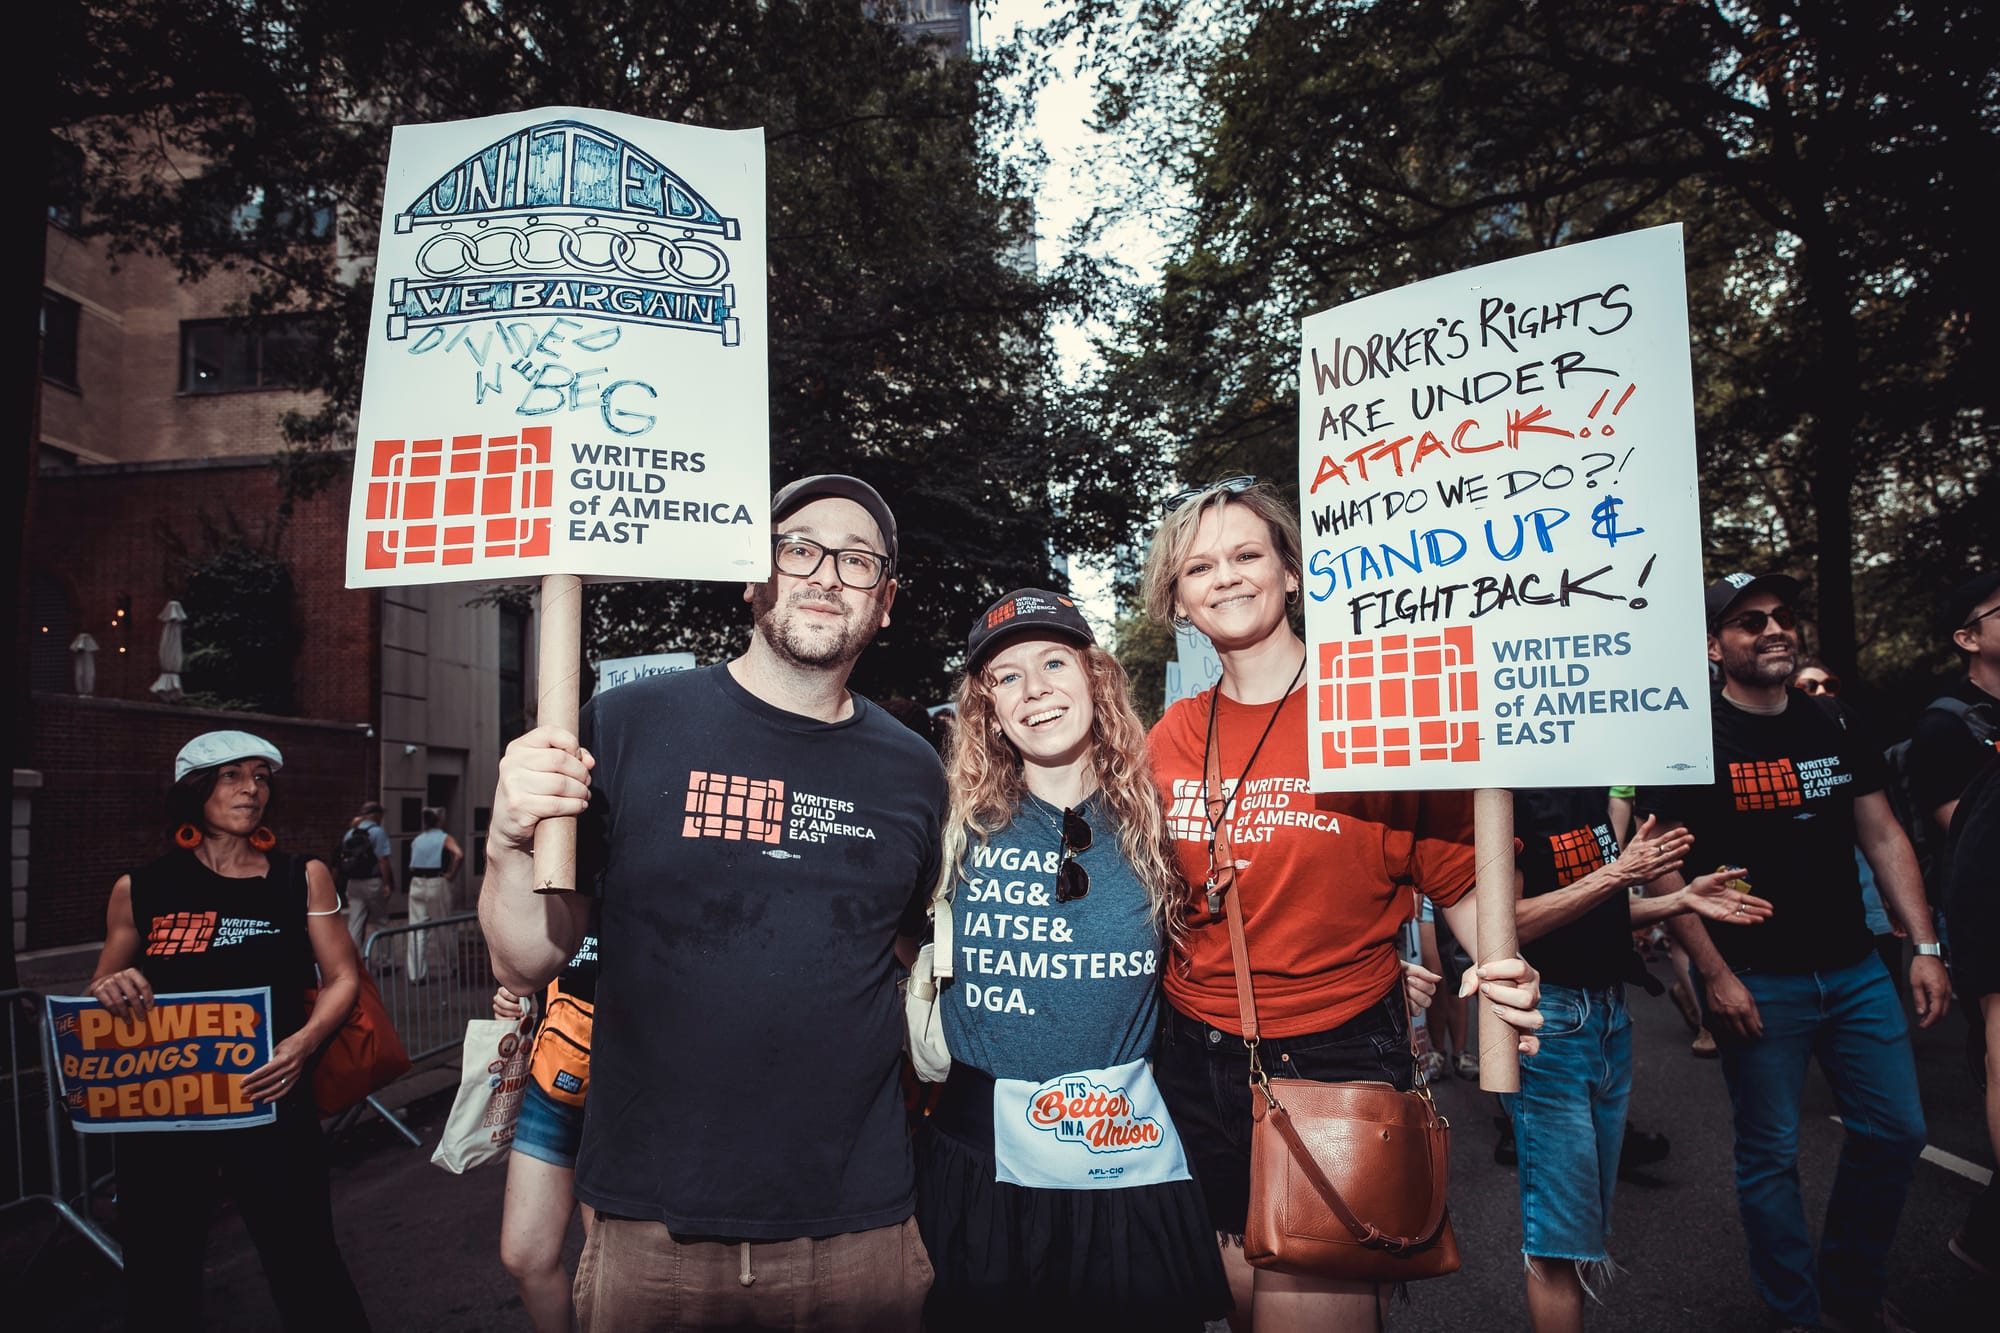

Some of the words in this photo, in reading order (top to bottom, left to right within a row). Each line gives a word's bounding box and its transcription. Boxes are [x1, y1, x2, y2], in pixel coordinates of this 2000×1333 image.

[431, 126, 703, 219] UNITED
[417, 284, 495, 314] WE
[514, 282, 715, 324] BARGAIN
[408, 317, 623, 366] DIVIDED
[1311, 316, 1470, 396] WORKER'S
[516, 362, 658, 437] BEG
[1318, 398, 1394, 442] ARE
[1412, 351, 1620, 420] UNDER
[1310, 383, 1637, 494] ATTACK!!
[571, 443, 706, 473] WRITERS
[571, 469, 666, 494] GUILD
[1437, 474, 1489, 511] WE
[569, 497, 600, 516] of
[609, 499, 754, 525] AMERICA
[569, 520, 649, 544] EAST
[1308, 528, 1468, 602] STAND
[1485, 506, 1571, 562] UP
[1347, 582, 1469, 635] FIGHT
[1492, 631, 1632, 664] WRITERS
[1493, 664, 1590, 691] GUILD
[1495, 696, 1524, 718] of
[1534, 687, 1689, 717] AMERICA
[1496, 720, 1575, 746] EAST
[1796, 756, 1840, 771] WRITERS
[1800, 768, 1832, 780] GUILD
[1803, 780, 1814, 789] of
[1805, 787, 1831, 799] EAST
[791, 804, 836, 821] GUILD
[793, 791, 855, 813] WRITERS
[1241, 794, 1290, 811] GUILD
[789, 828, 828, 844] EAST
[790, 818, 806, 829] of
[808, 819, 876, 840] AMERICA
[1234, 827, 1275, 844] EAST
[1237, 811, 1251, 827] of
[1254, 810, 1341, 834] AMERICA
[974, 846, 1060, 874] WGA&
[967, 878, 1050, 906] SAG&
[964, 912, 1073, 942] IATSE&
[962, 946, 1157, 980] TEAMSTERS&
[966, 983, 1036, 1016] DGA.
[79, 1003, 256, 1051] POWER
[63, 1043, 200, 1080] BELONGS
[214, 1042, 256, 1067] TO
[87, 1073, 254, 1119] PEOPLE
[1065, 1083, 1087, 1098] IT'S
[1032, 1091, 1130, 1124] Better
[1061, 1121, 1074, 1136] IN
[1076, 1120, 1085, 1136] A
[1086, 1118, 1159, 1147] Union
[1088, 1167, 1124, 1175] AFL-CIO
